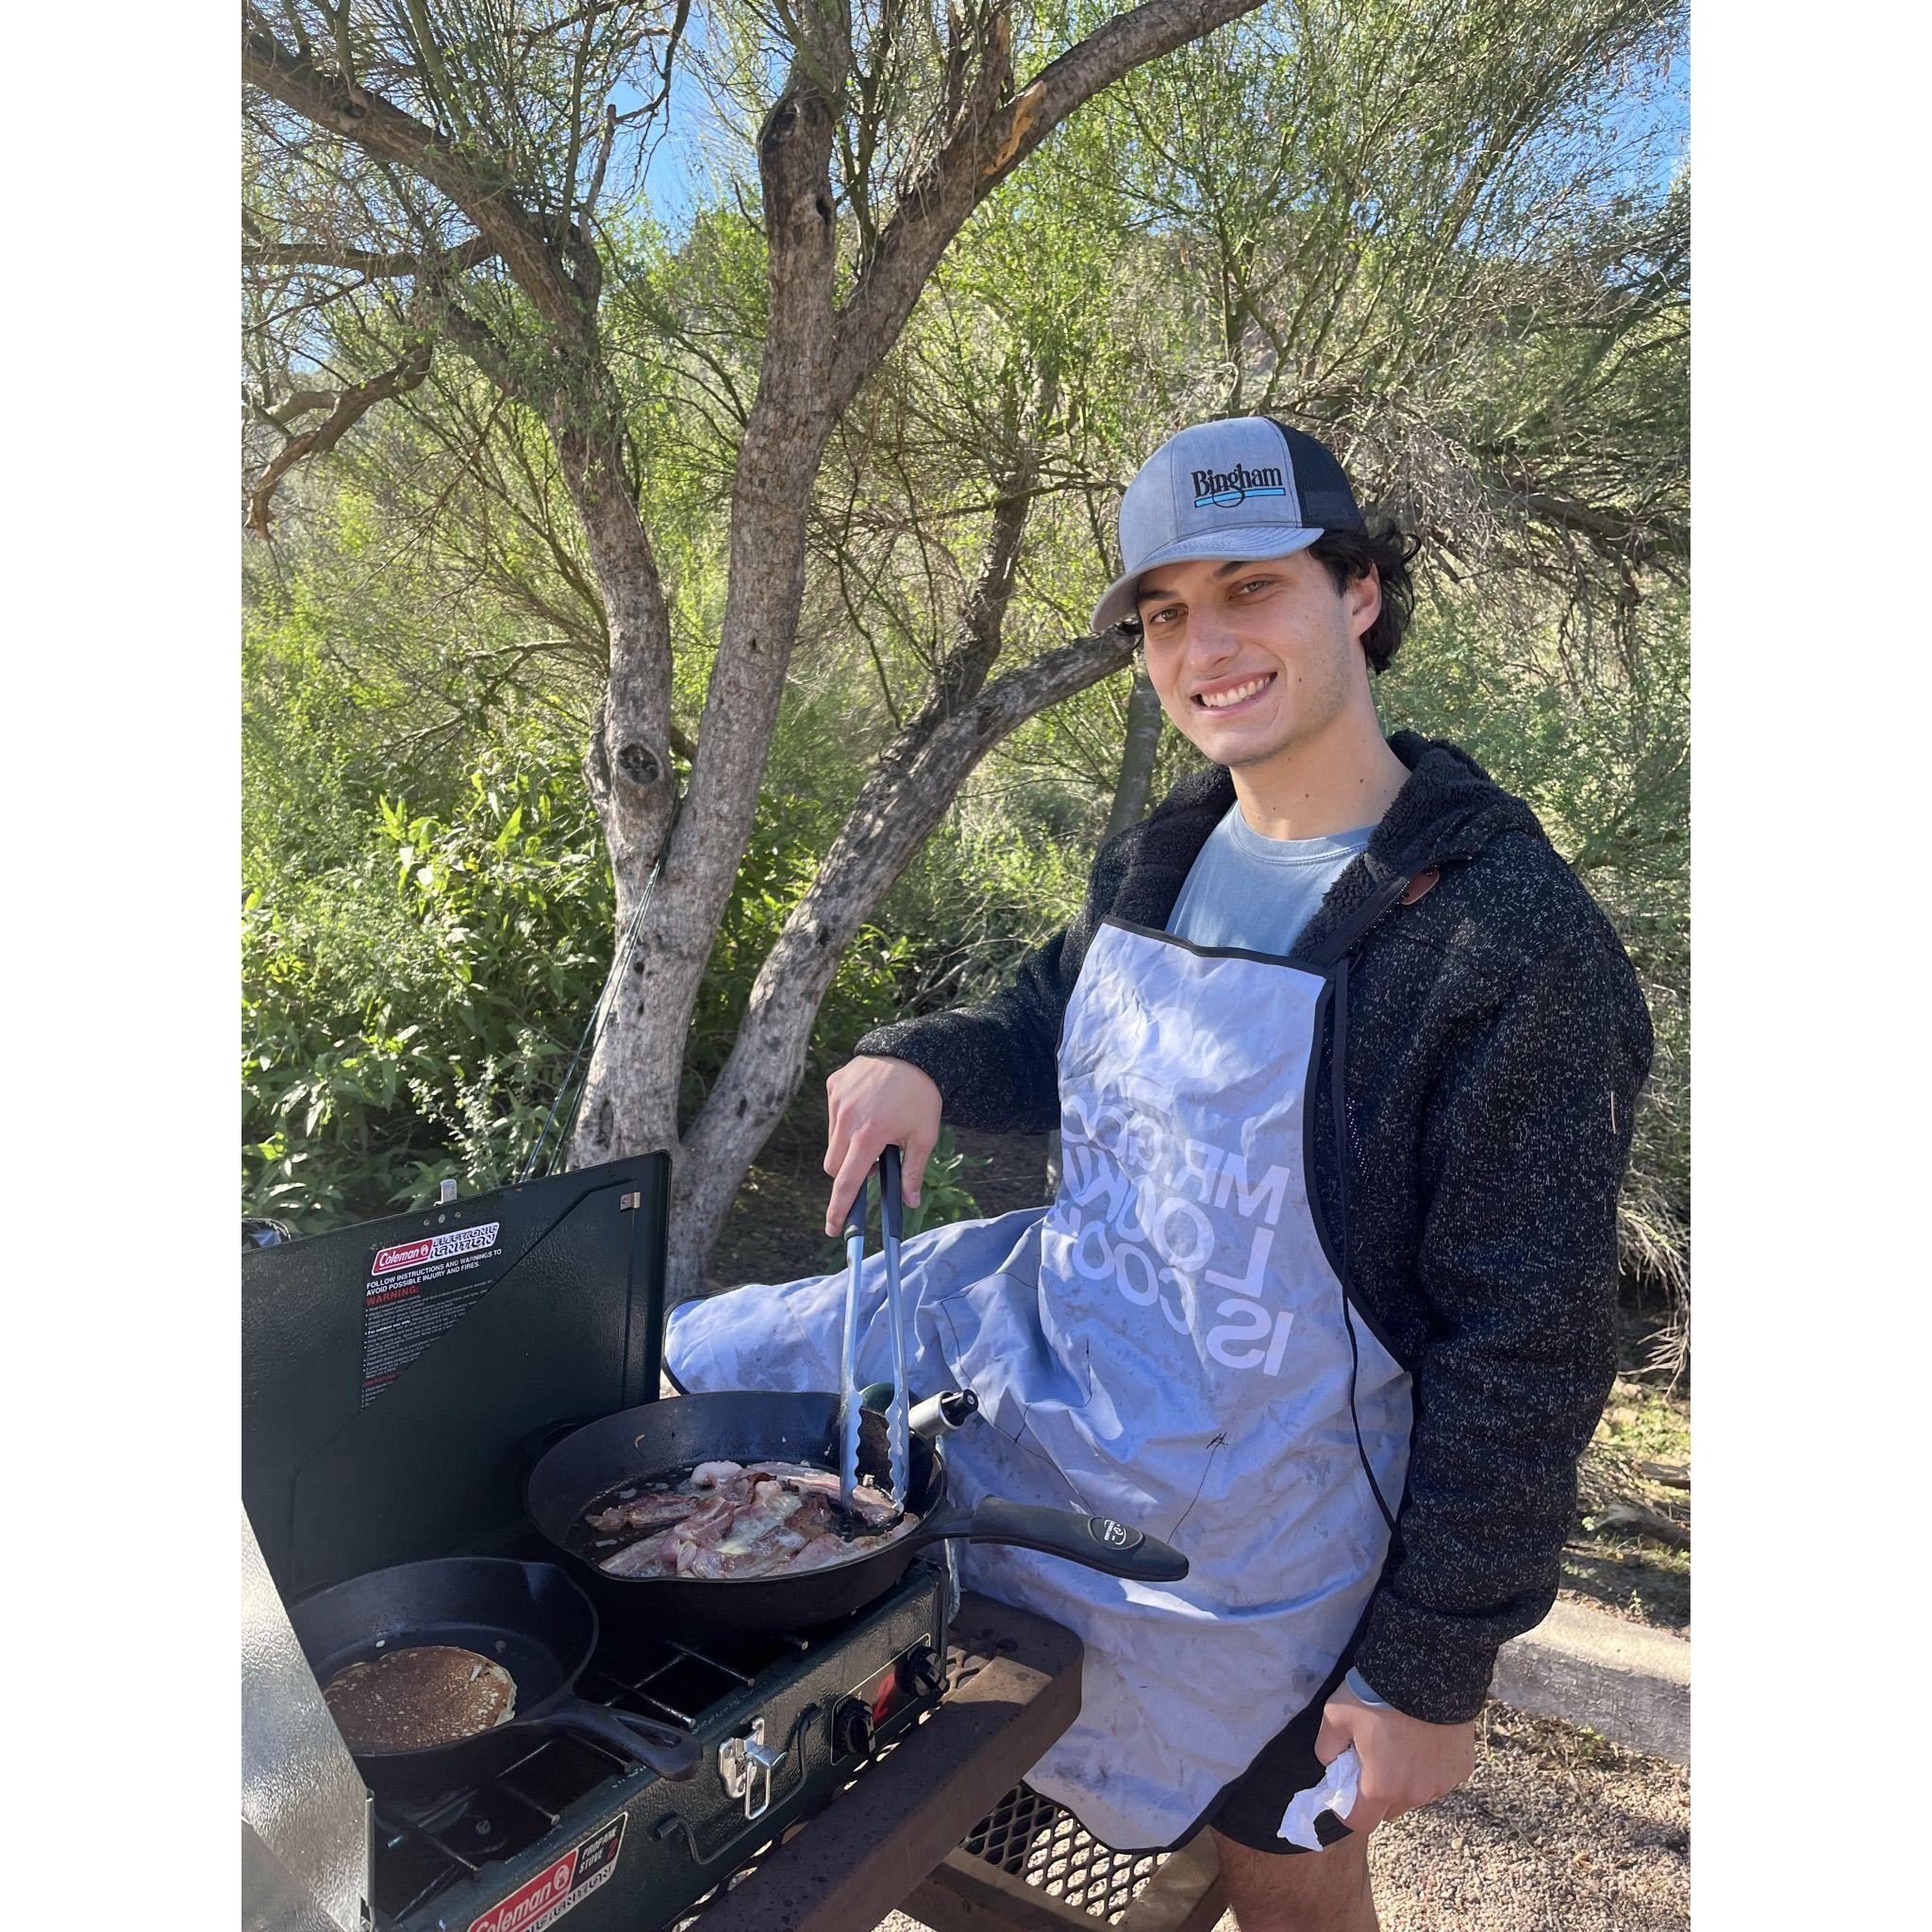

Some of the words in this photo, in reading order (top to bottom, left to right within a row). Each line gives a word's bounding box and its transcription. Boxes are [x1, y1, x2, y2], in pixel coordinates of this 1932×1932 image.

[1191, 463, 1283, 508] Bingham
[430, 1234, 496, 1259] IGNITION
[433, 1224, 498, 1246] ELECTRONIC
[379, 1248, 420, 1267] Coleman
[366, 1275, 396, 1290] FOLLOW
[396, 1263, 444, 1281] INSTRUCTIONS
[445, 1259, 459, 1268] AND
[459, 1252, 492, 1265] WARNINGS
[366, 1286, 388, 1297] AVOID
[389, 1276, 422, 1291] POSSIBLE
[422, 1270, 445, 1282] INJURY
[447, 1266, 460, 1274] AND
[366, 1287, 419, 1306] WARNING:
[582, 1826, 619, 1858] PROPANE
[578, 1848, 604, 1874] STOVE
